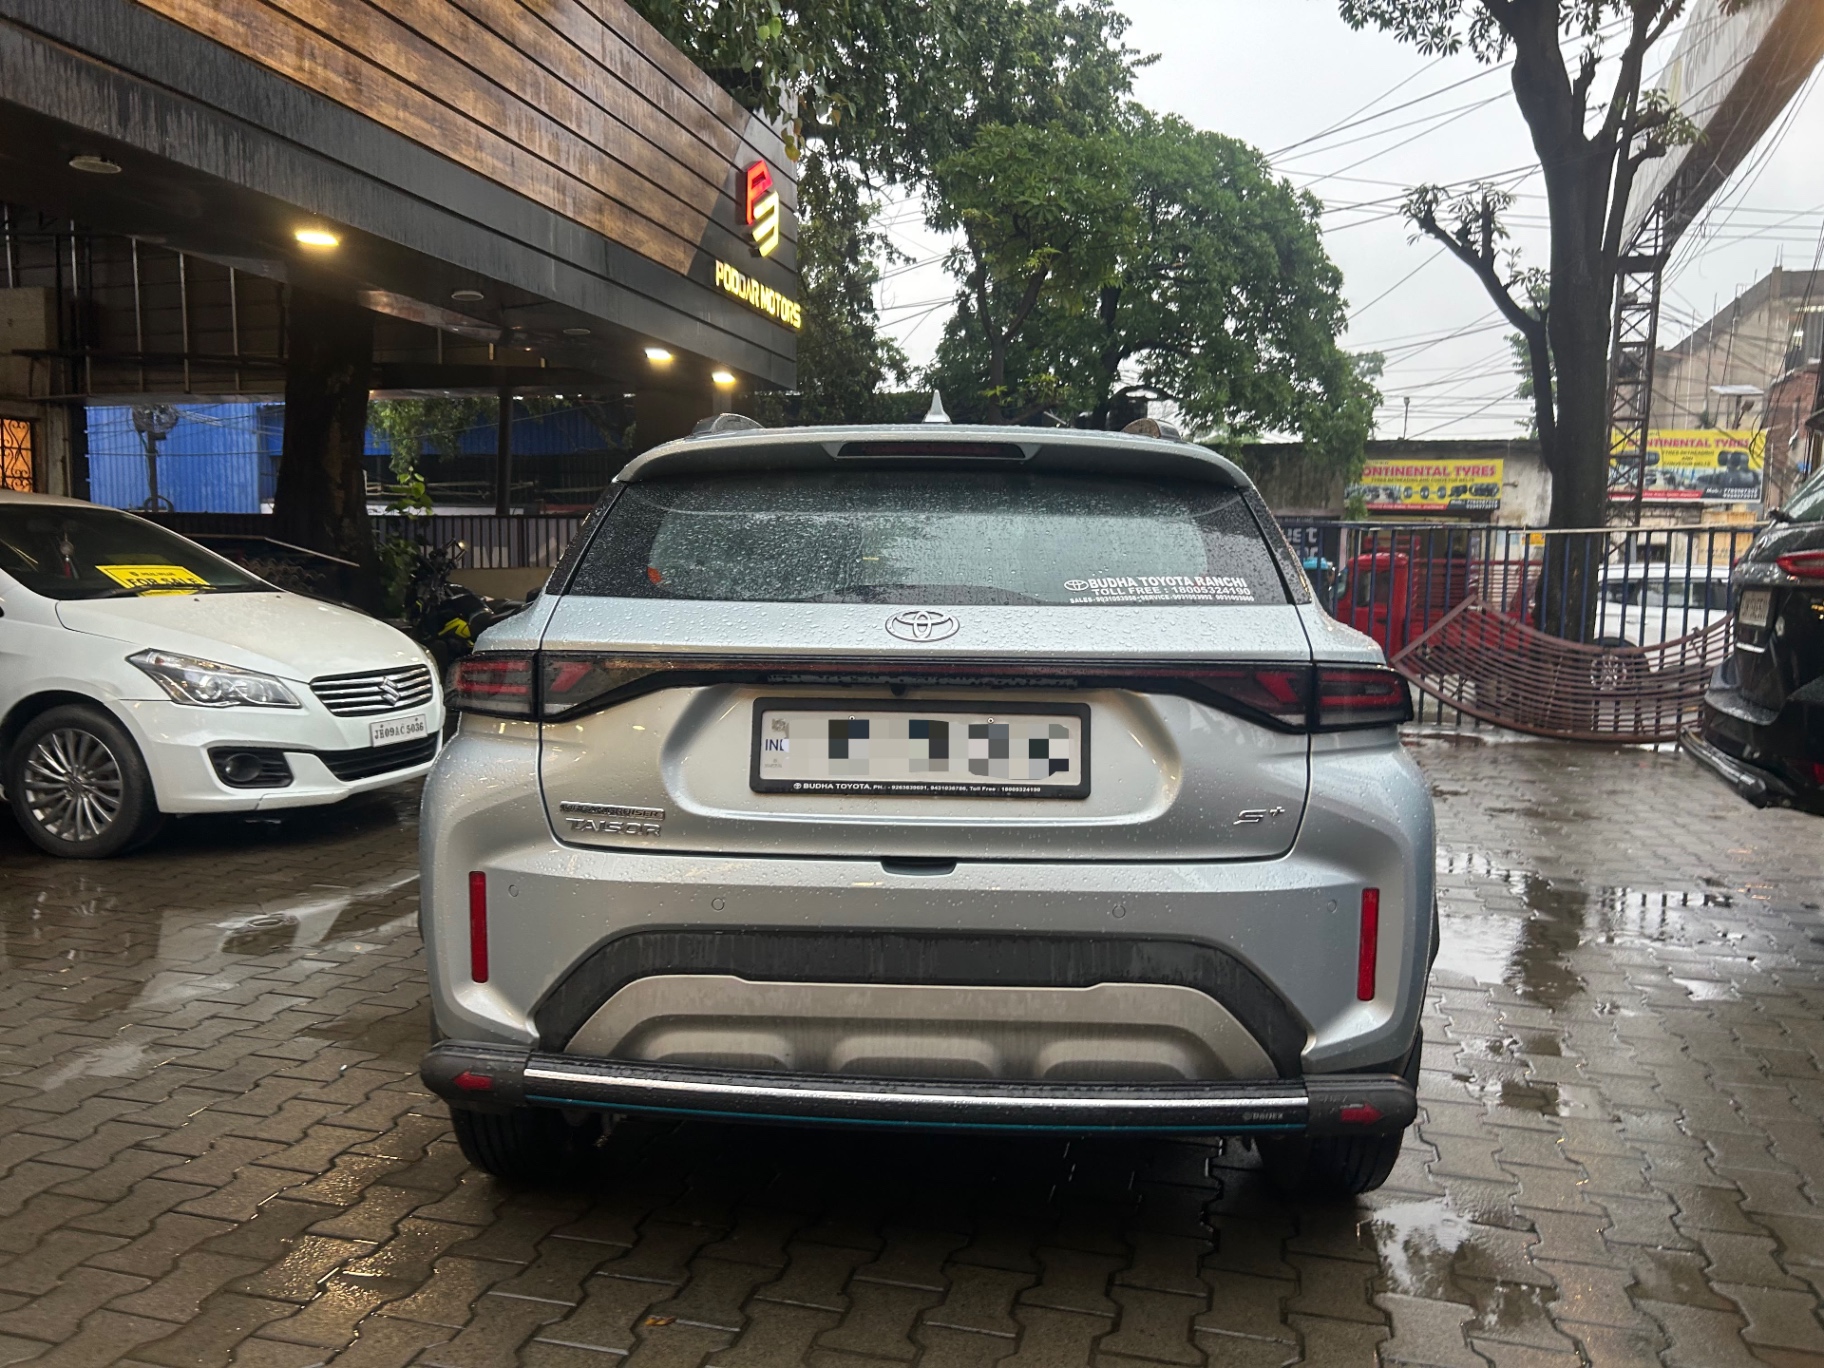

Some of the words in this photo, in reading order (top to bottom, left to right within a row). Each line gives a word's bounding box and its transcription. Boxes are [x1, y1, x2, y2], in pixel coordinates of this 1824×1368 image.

[715, 259, 760, 308] PODDAR
[760, 283, 802, 329] MOTORS
[1362, 465, 1450, 477] ONTINENTAL
[1453, 465, 1496, 477] TYRES
[125, 578, 158, 587] FOR
[160, 577, 197, 586] SALE
[1087, 576, 1137, 589] BUDHA
[1137, 576, 1195, 587] TOYOTA
[1194, 576, 1248, 587] RANCHI
[1092, 588, 1126, 596] TOLL
[1128, 587, 1162, 595] FREE
[1171, 586, 1251, 596] 18005324190
[406, 722, 424, 734] 5036
[803, 782, 834, 790] BUDHA
